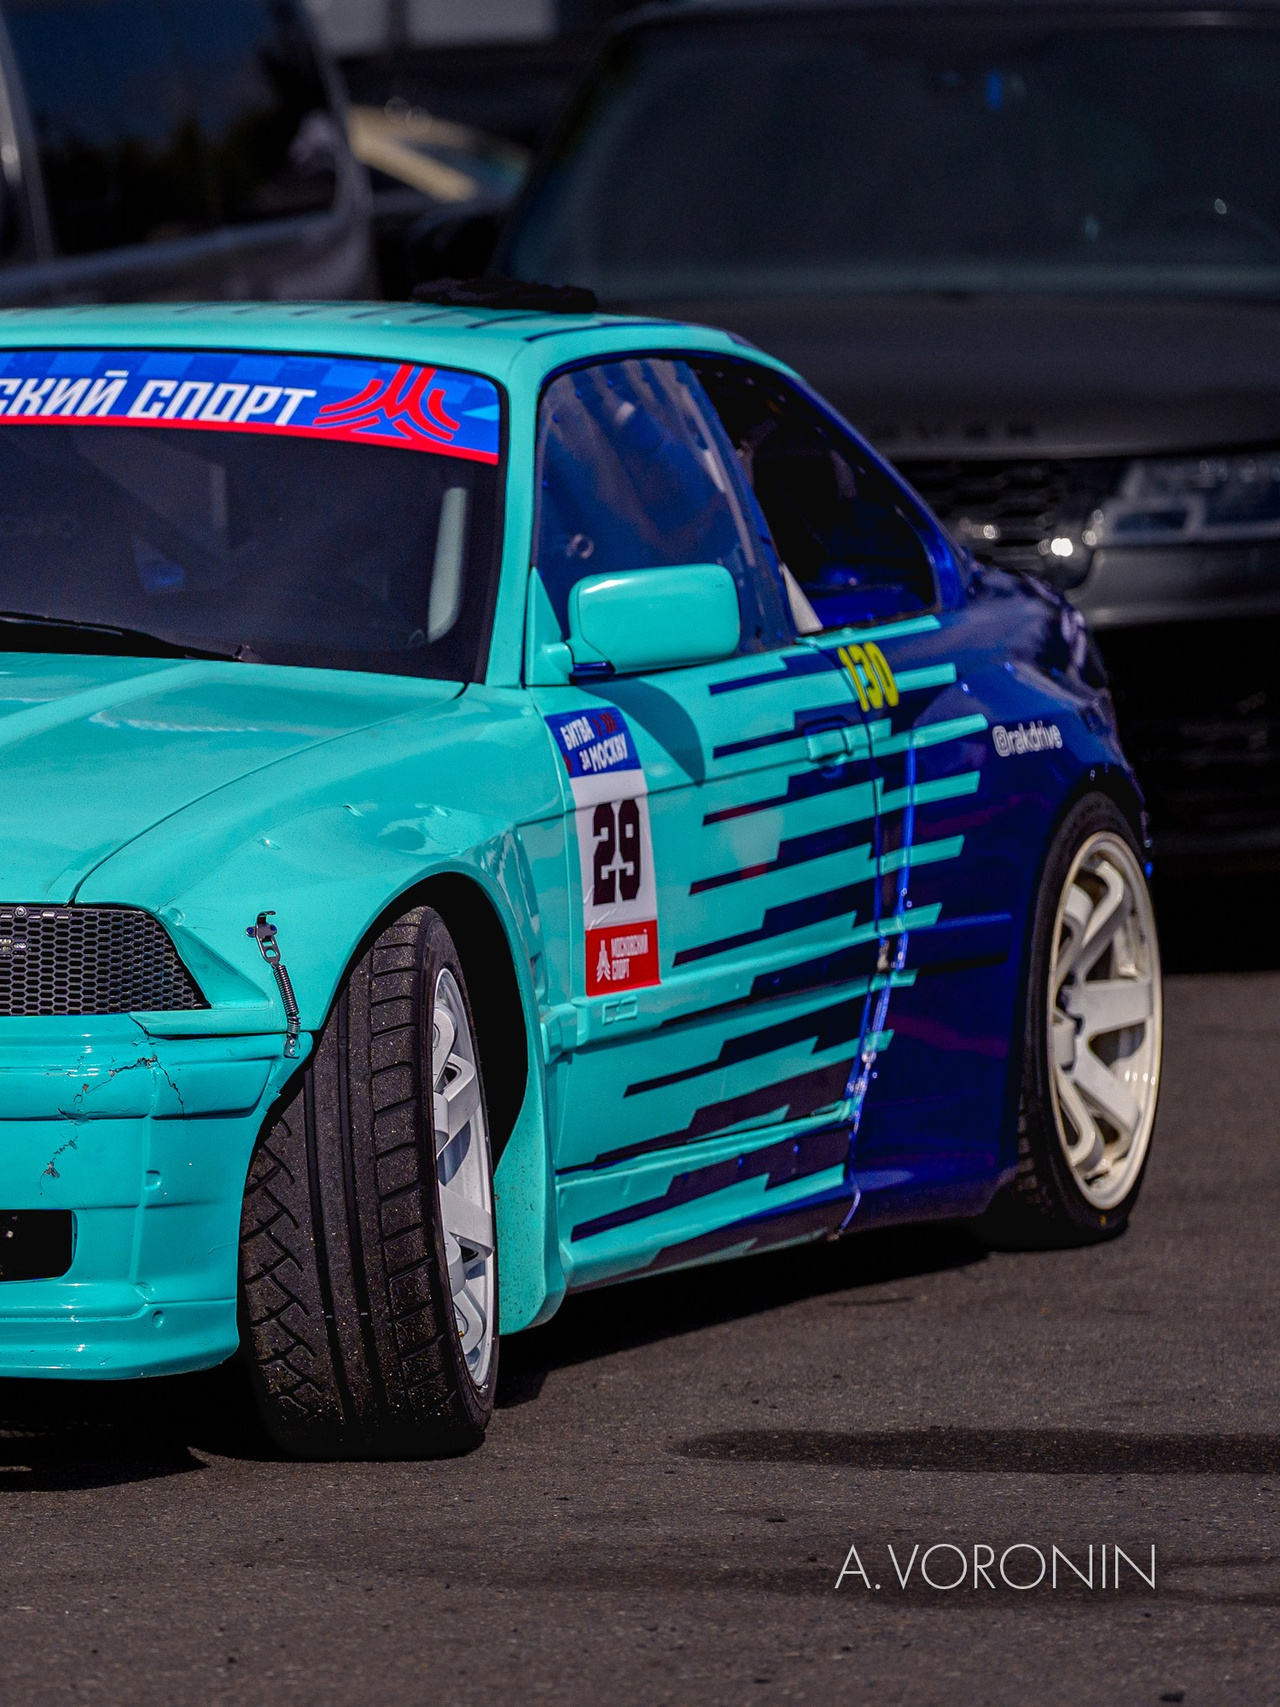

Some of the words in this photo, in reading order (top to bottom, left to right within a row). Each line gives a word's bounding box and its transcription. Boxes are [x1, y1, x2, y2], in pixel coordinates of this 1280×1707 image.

[127, 379, 317, 426] СПОРТ
[837, 641, 899, 712] 130
[560, 716, 595, 751] БИТВА
[588, 732, 628, 772] МОСКВУ
[593, 799, 641, 905] 29
